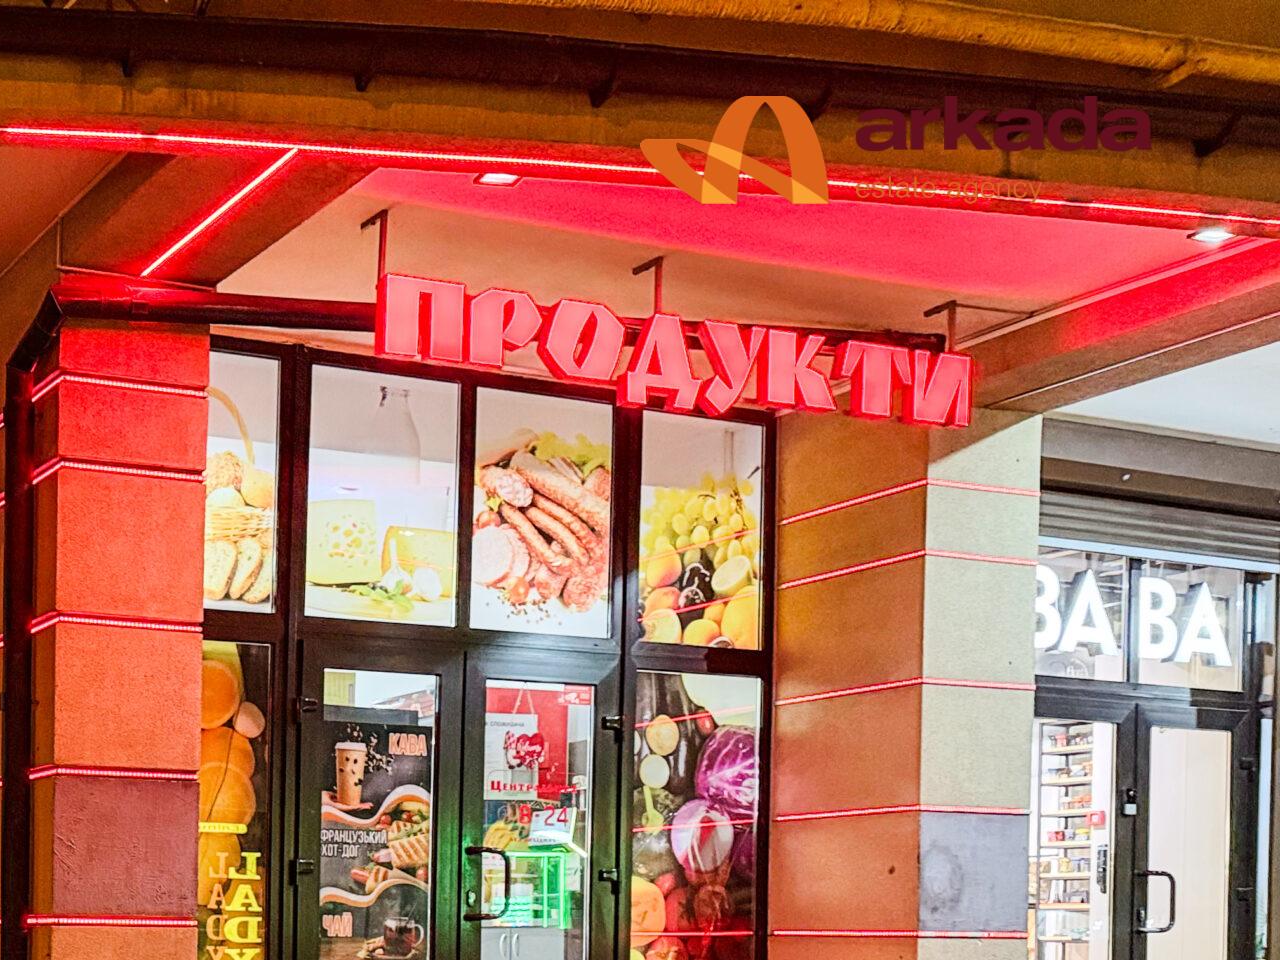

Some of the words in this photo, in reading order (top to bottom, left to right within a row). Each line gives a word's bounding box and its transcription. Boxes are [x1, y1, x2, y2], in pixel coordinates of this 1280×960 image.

[375, 272, 974, 428] ПРОДУКТИ
[388, 732, 428, 757] КАВА
[320, 829, 388, 845] ФРАНЦУЗЬКИЙ
[320, 843, 360, 858] ХОТ-ДОГ
[322, 911, 353, 938] ЧАЙ
